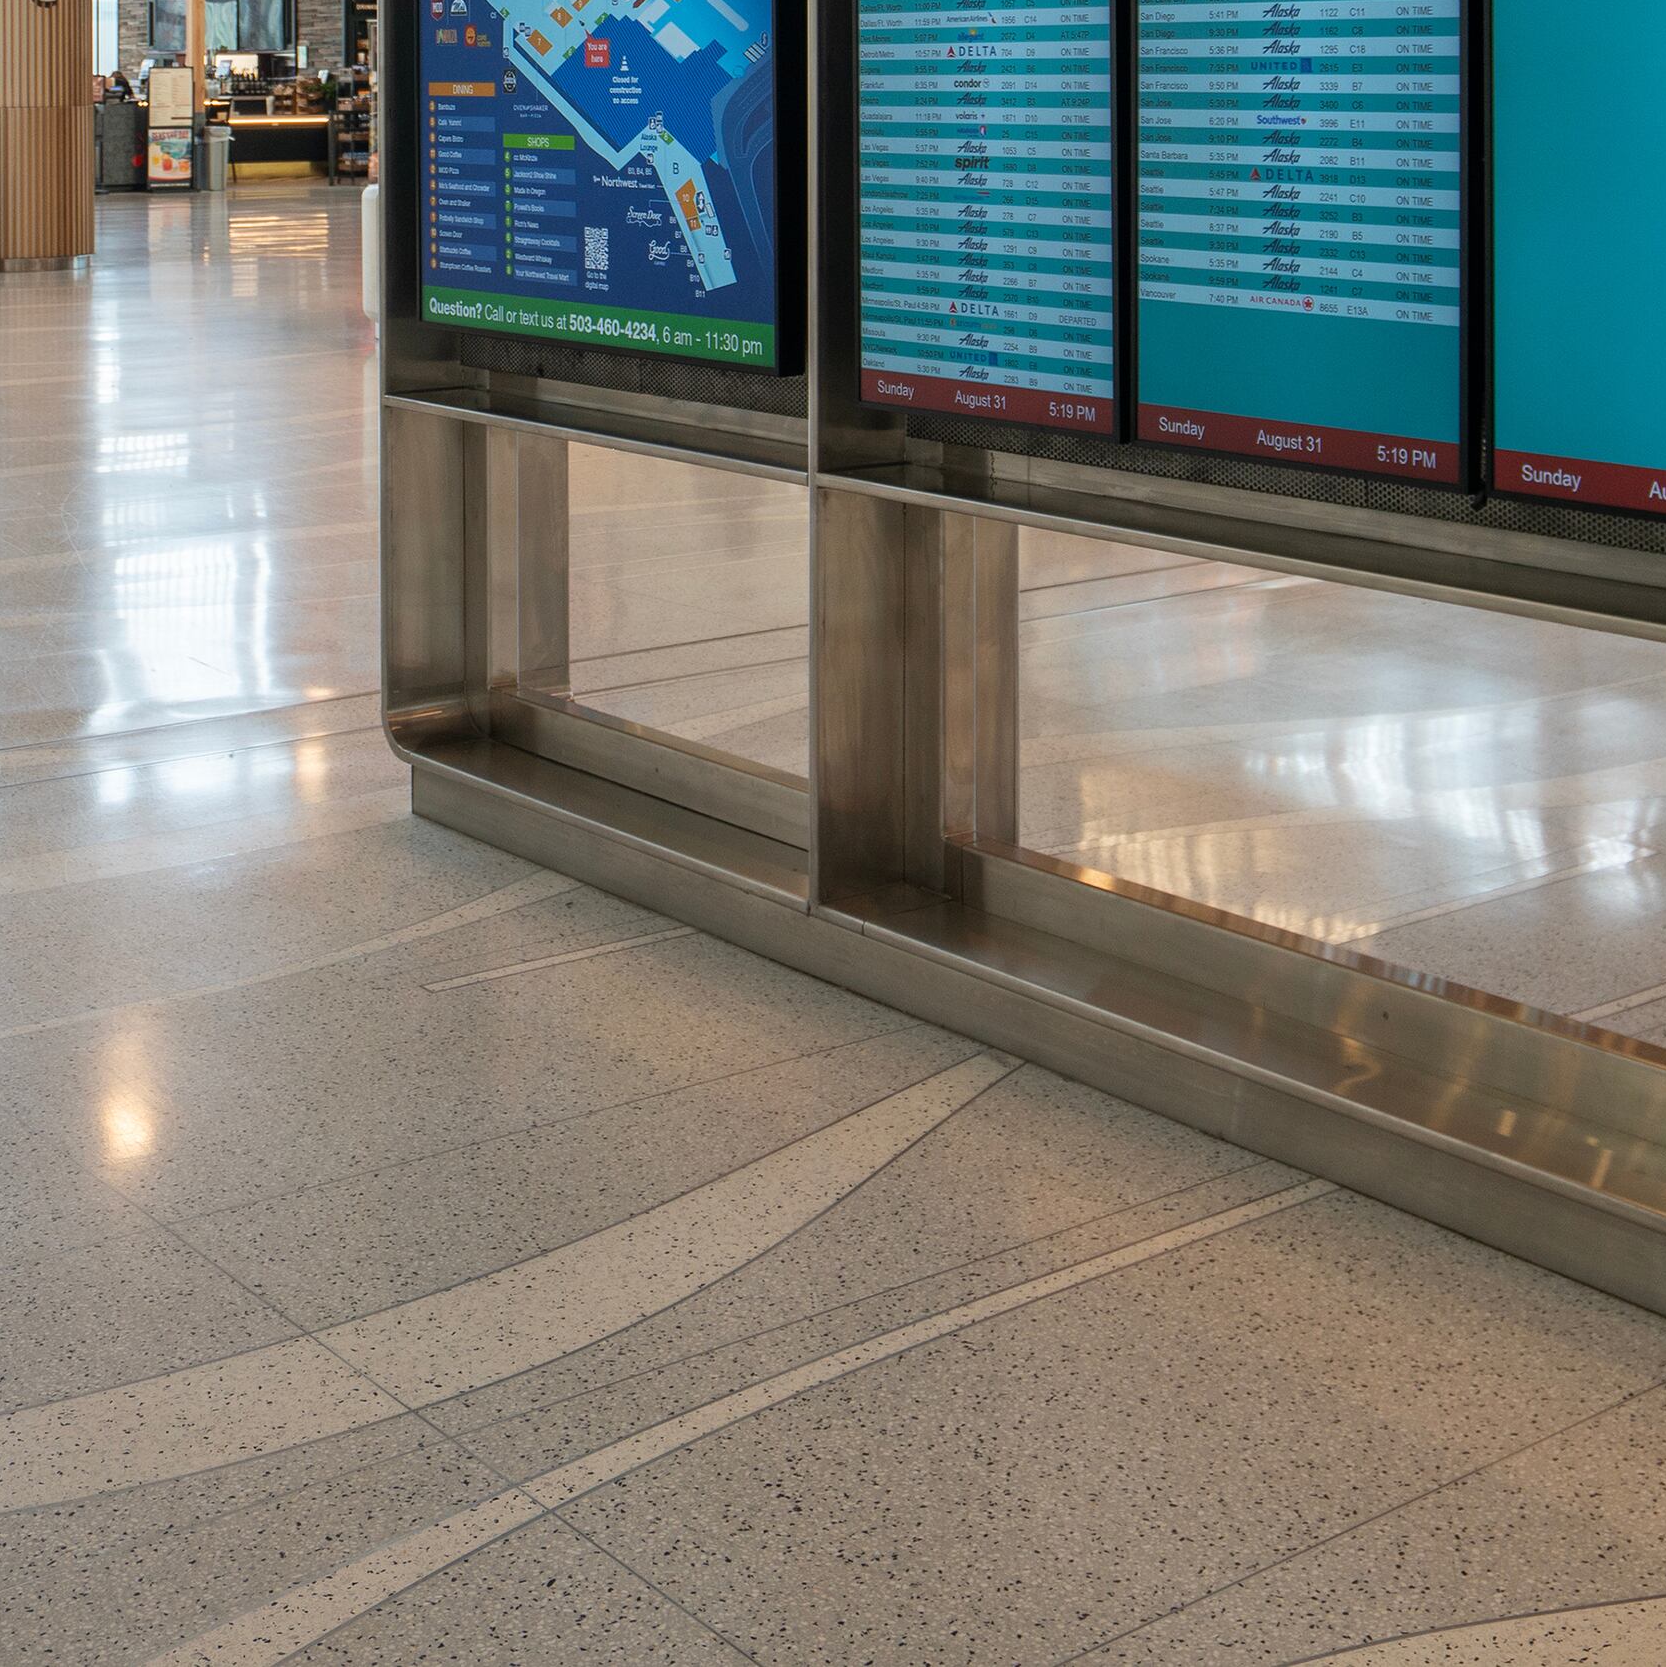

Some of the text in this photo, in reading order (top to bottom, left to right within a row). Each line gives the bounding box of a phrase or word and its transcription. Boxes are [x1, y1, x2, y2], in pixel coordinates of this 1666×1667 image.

[452, 85, 473, 95] DINING
[954, 78, 982, 89] condor
[527, 137, 550, 148] SHOPS
[601, 176, 638, 189] Northwest
[1250, 296, 1301, 307] AIR CANADA
[429, 297, 482, 320] Question?
[485, 303, 504, 323] Call
[506, 309, 517, 324] or
[519, 310, 540, 327] text
[541, 315, 554, 329] us
[556, 316, 567, 331] at
[569, 313, 660, 345] 503-460-4234,
[662, 327, 671, 343] 6
[674, 332, 693, 347] am
[705, 331, 739, 351] 11:30
[743, 336, 763, 357] pm
[877, 379, 1096, 421] Sunday August 31 5:19 PM
[1158, 416, 1436, 469] Sunday August 31 5:19 PM
[1521, 464, 1582, 493] Sunday
